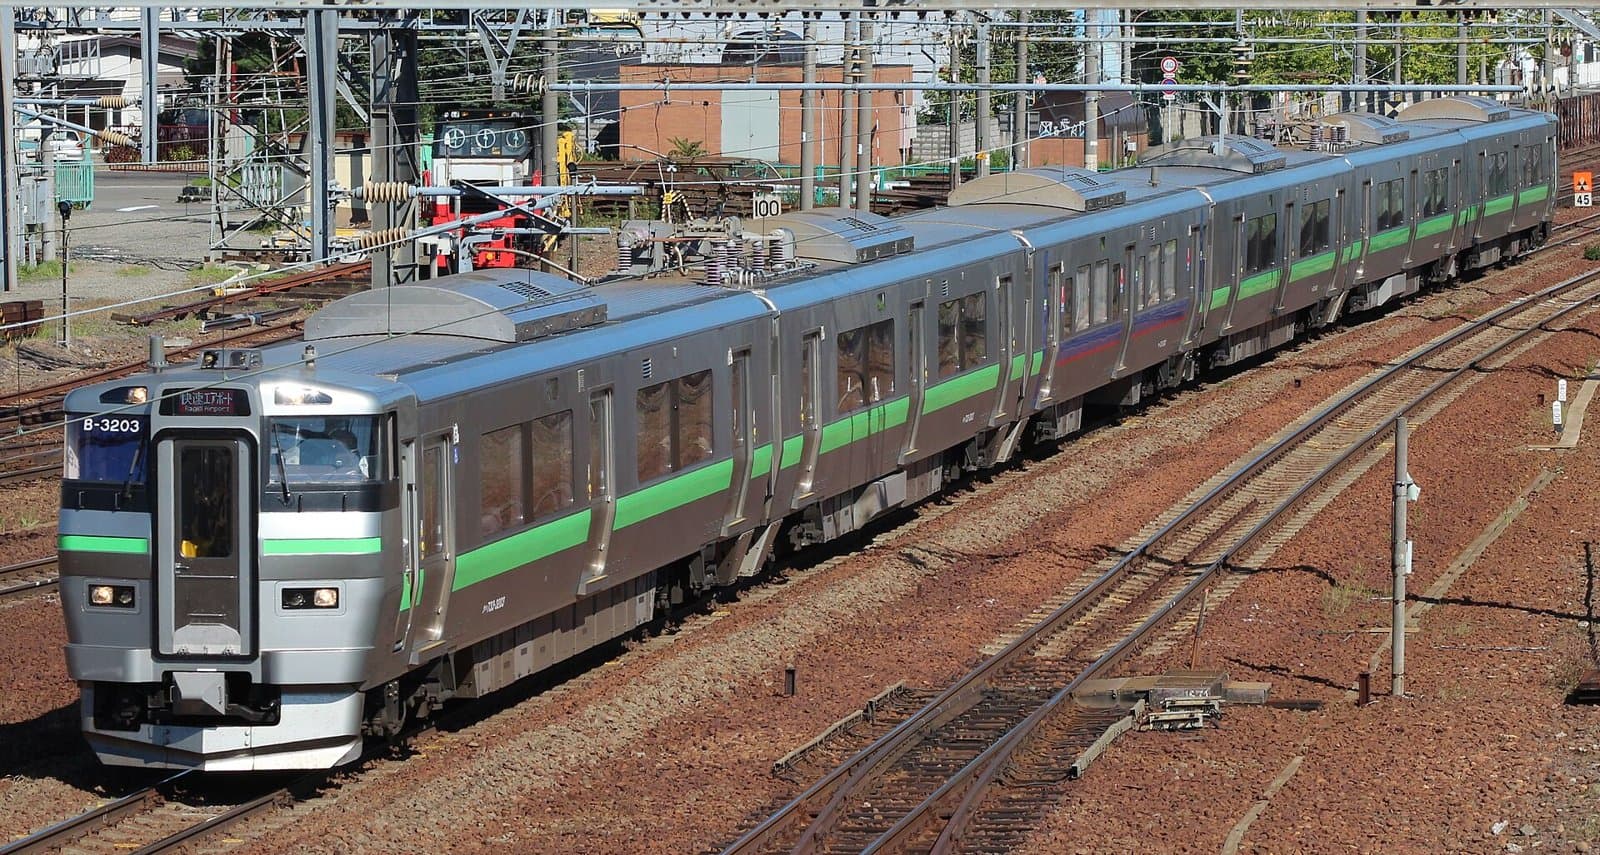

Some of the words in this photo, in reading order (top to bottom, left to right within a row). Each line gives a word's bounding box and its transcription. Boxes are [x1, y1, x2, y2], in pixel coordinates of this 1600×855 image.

[1577, 195, 1590, 205] 45
[755, 200, 779, 217] 100
[83, 418, 140, 433] B-3203
